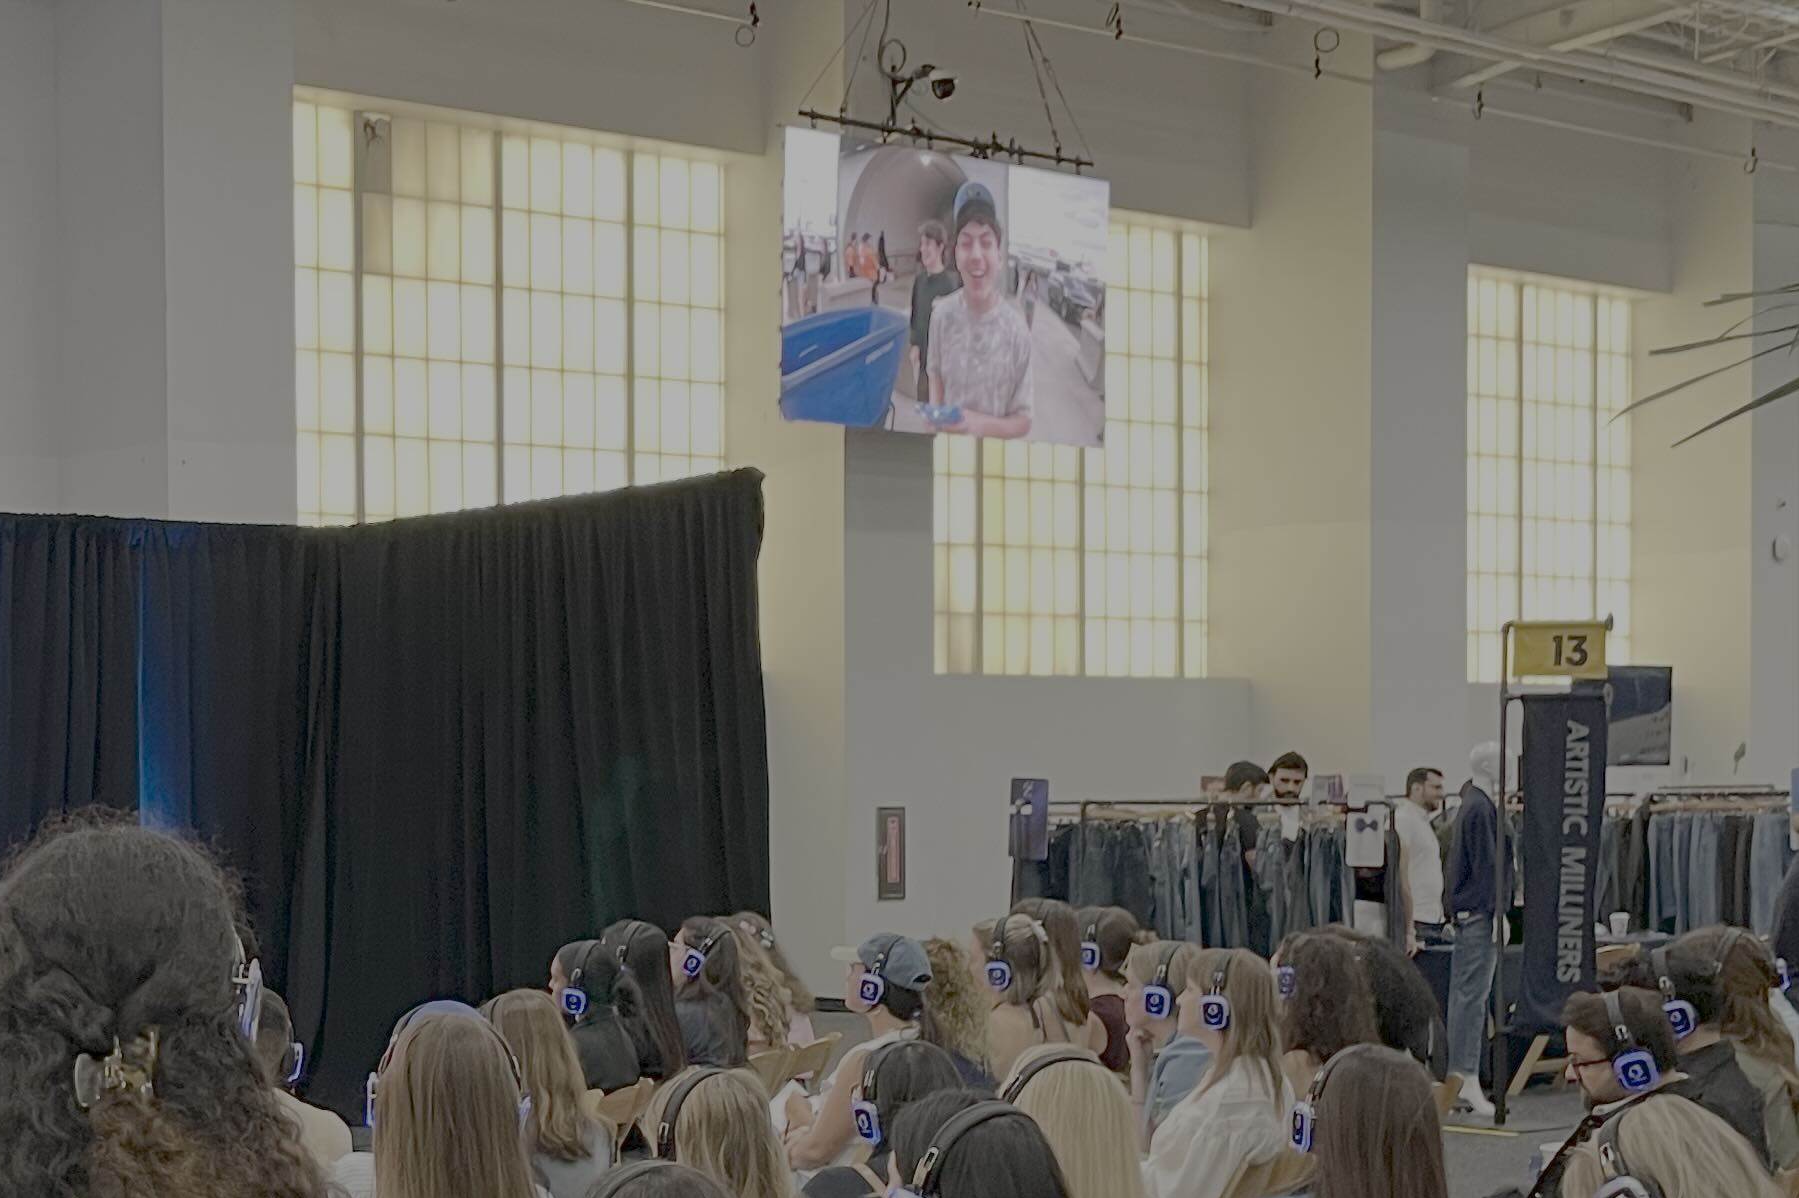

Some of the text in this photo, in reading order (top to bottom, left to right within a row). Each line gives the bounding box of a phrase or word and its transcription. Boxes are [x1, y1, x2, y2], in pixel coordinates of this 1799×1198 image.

[1552, 635, 1588, 666] 13
[1556, 719, 1591, 984] ARTISTIC MILLINERS
